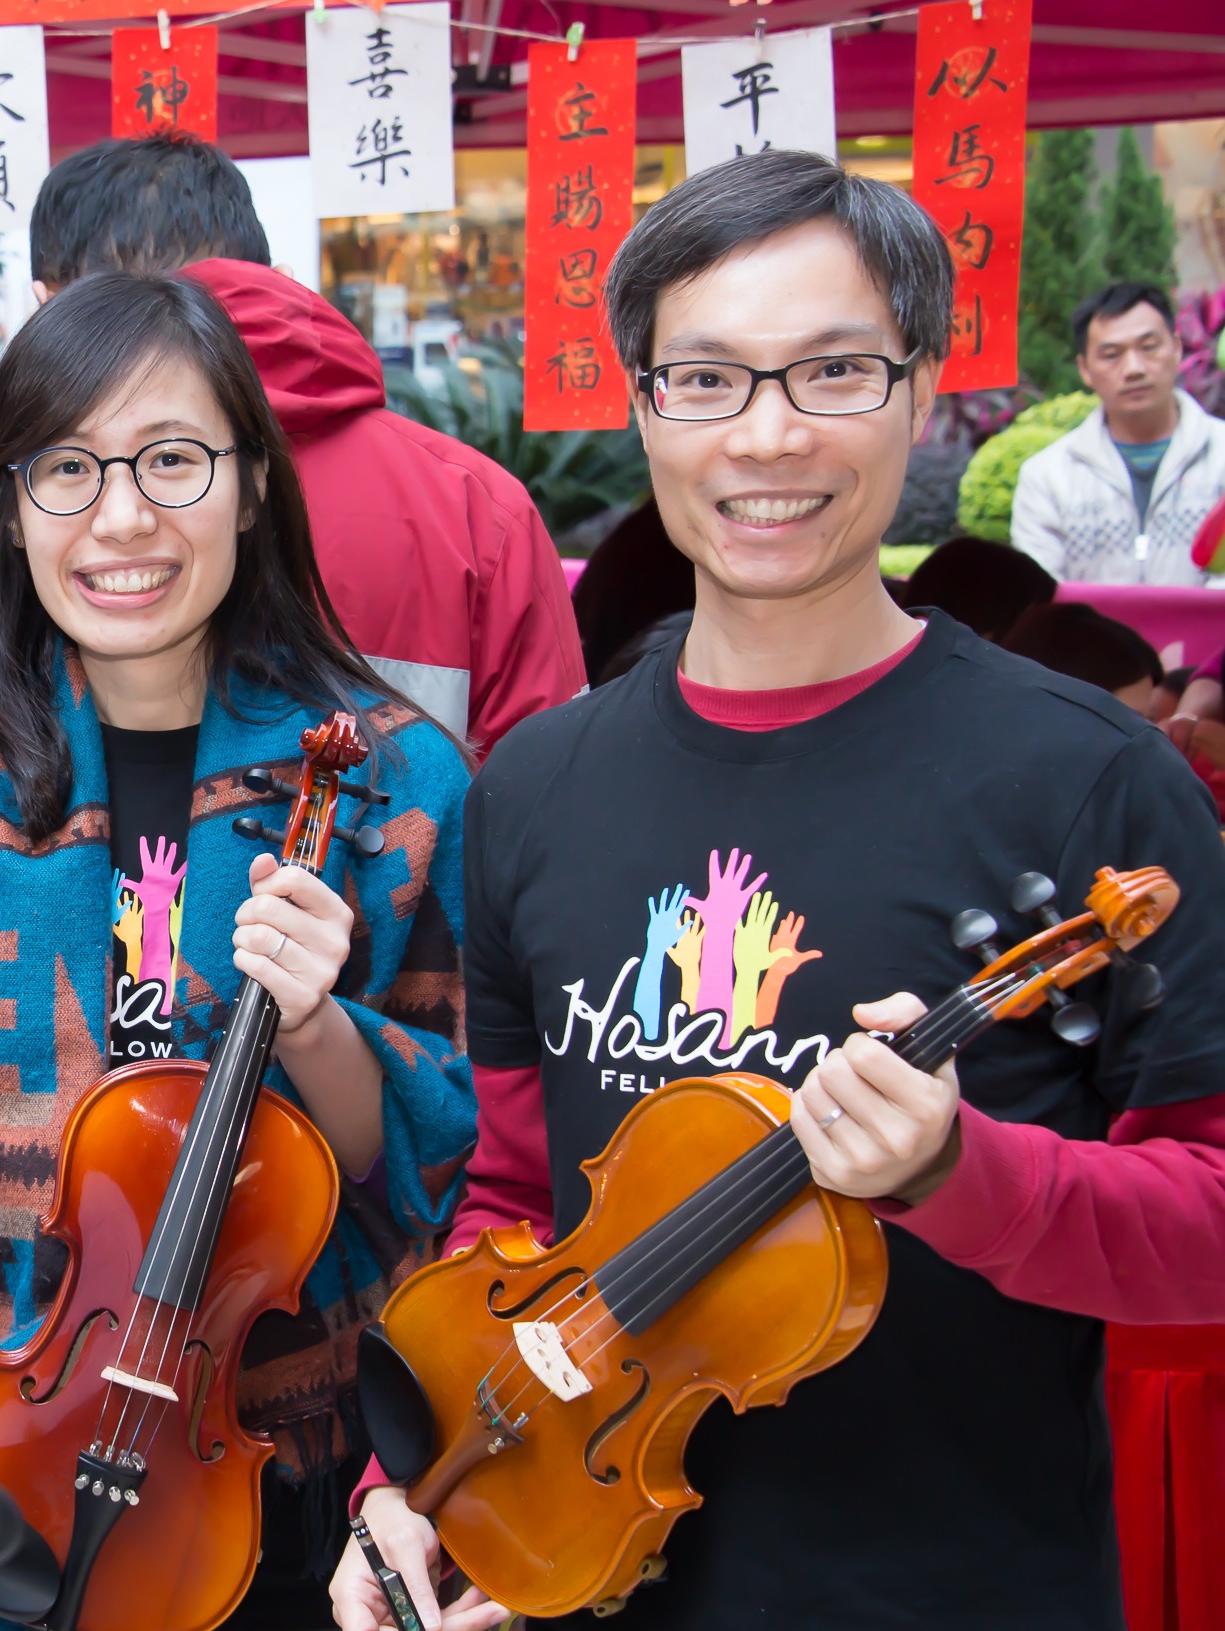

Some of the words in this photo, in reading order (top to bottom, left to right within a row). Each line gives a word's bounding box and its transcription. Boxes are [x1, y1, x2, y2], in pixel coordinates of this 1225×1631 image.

[134, 65, 189, 125] 神
[349, 27, 413, 187] 喜樂
[545, 81, 609, 395] 主賜恩福
[544, 956, 895, 1074] Hosann
